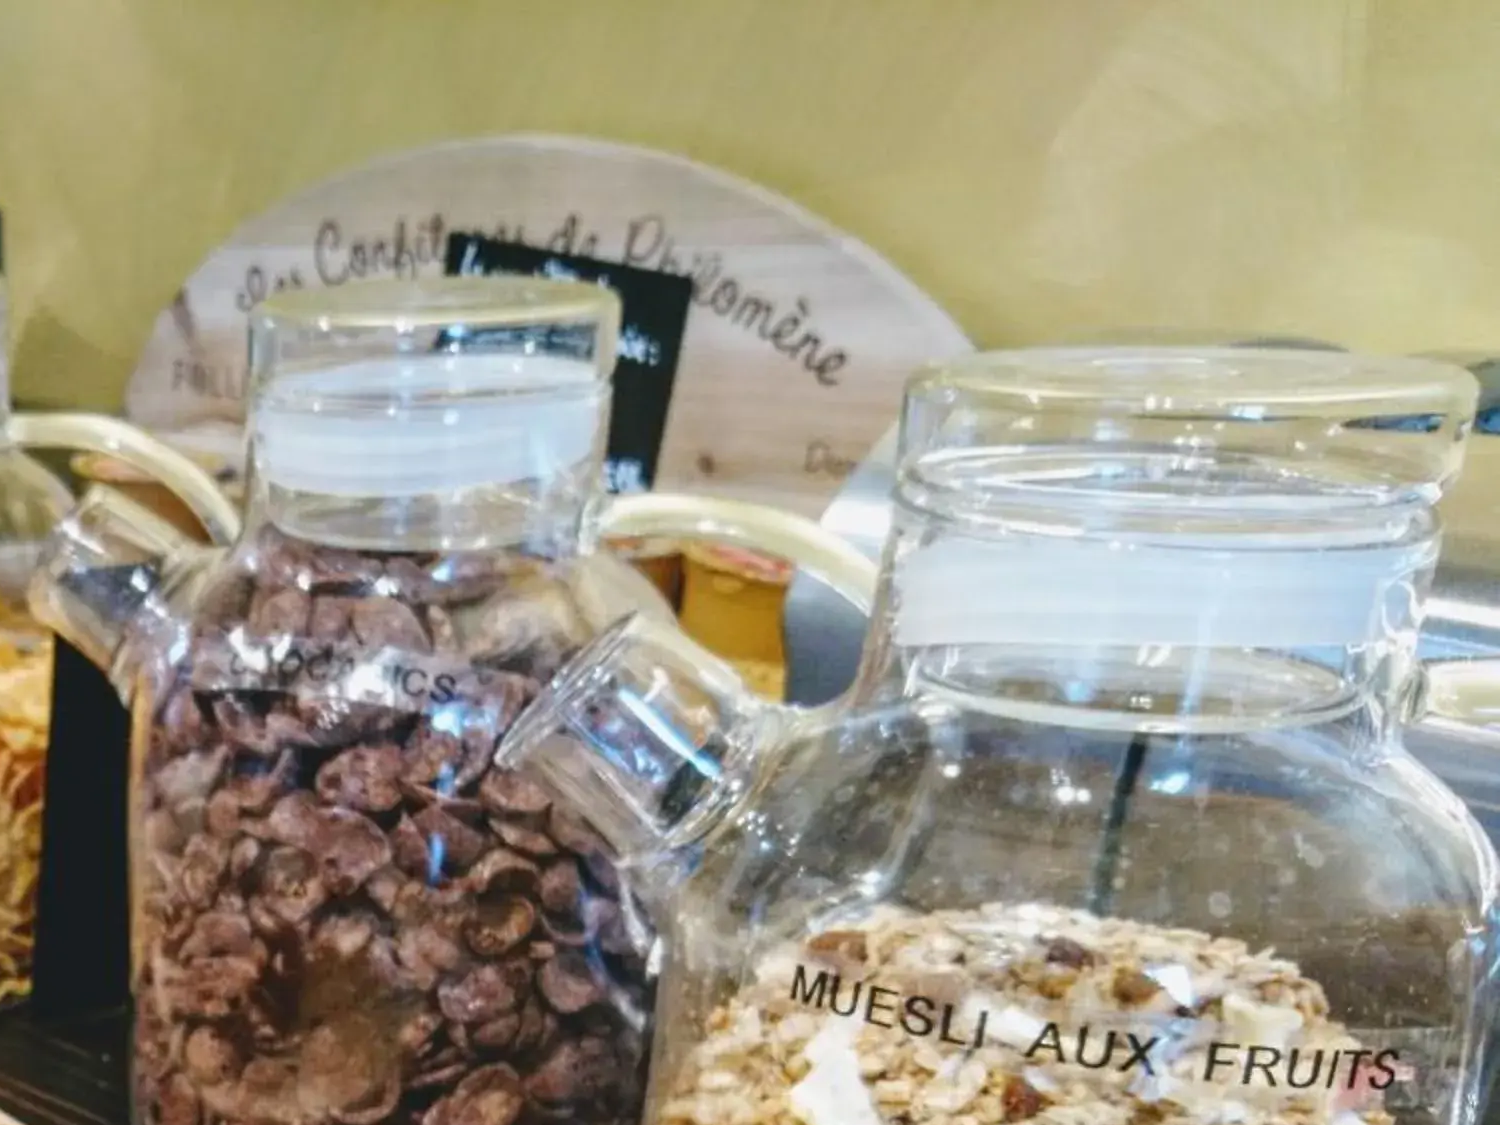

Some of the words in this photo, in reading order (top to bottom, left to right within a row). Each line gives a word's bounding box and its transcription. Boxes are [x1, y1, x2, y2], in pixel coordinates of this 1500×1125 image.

[790, 965, 988, 1053] MUESLI
[1025, 1021, 1160, 1077] AUX
[1202, 1041, 1401, 1091] FRUITS
